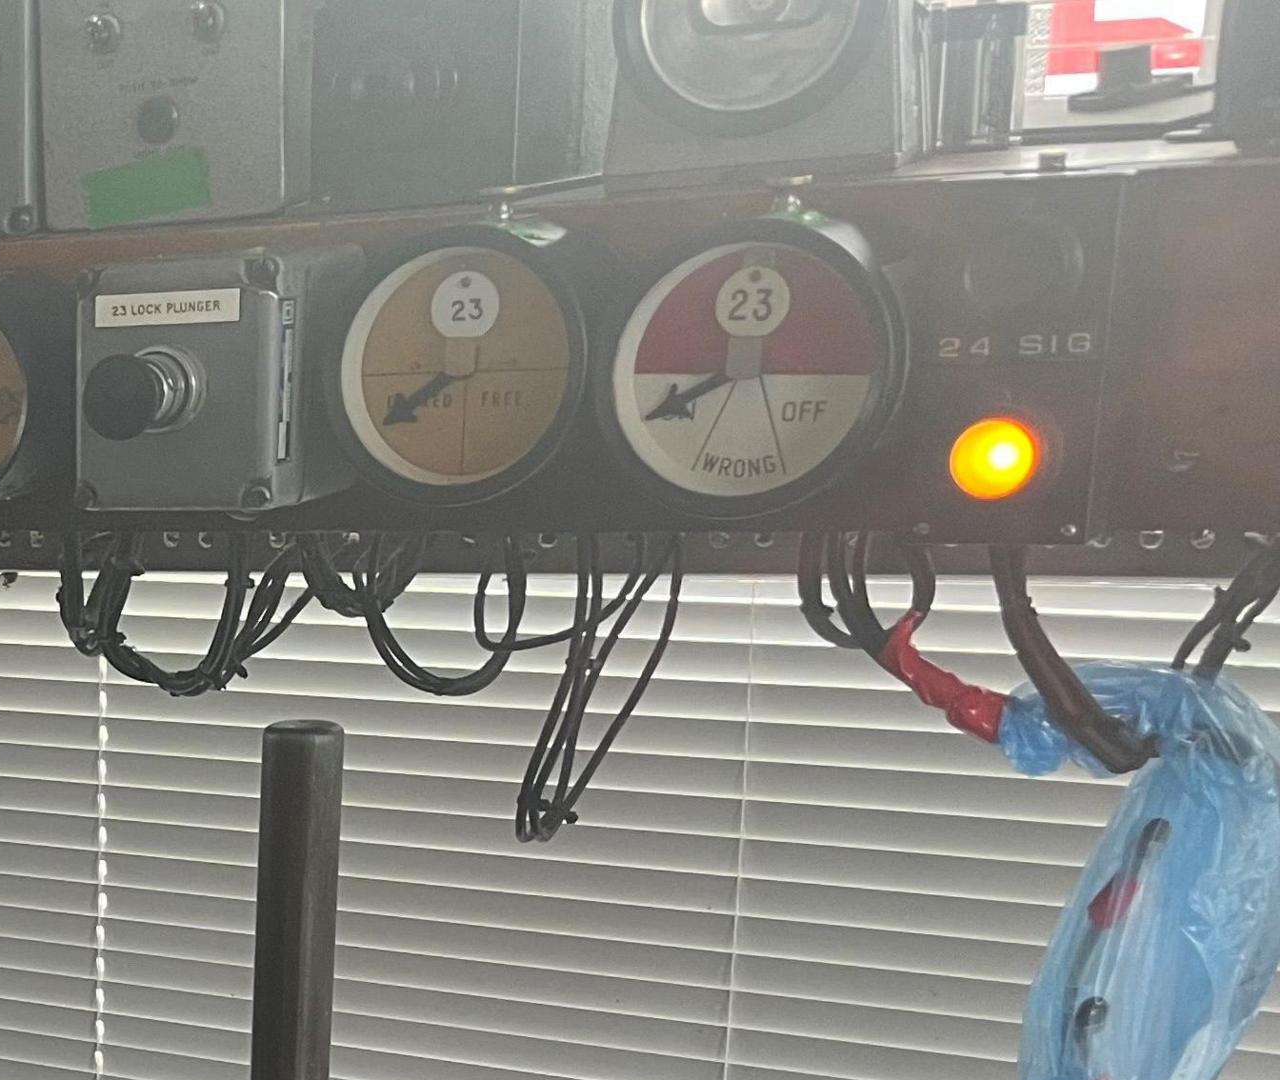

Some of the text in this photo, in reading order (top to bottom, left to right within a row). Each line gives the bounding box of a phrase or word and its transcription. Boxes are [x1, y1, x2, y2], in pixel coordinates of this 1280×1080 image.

[111, 300, 221, 317] 23 LOCK PLUNGER
[451, 298, 483, 321] 23
[728, 288, 773, 322] 23
[939, 332, 1092, 358] 24 SIG
[481, 391, 521, 408] FREE
[781, 400, 828, 422] OFF
[702, 452, 777, 478] WRONG
